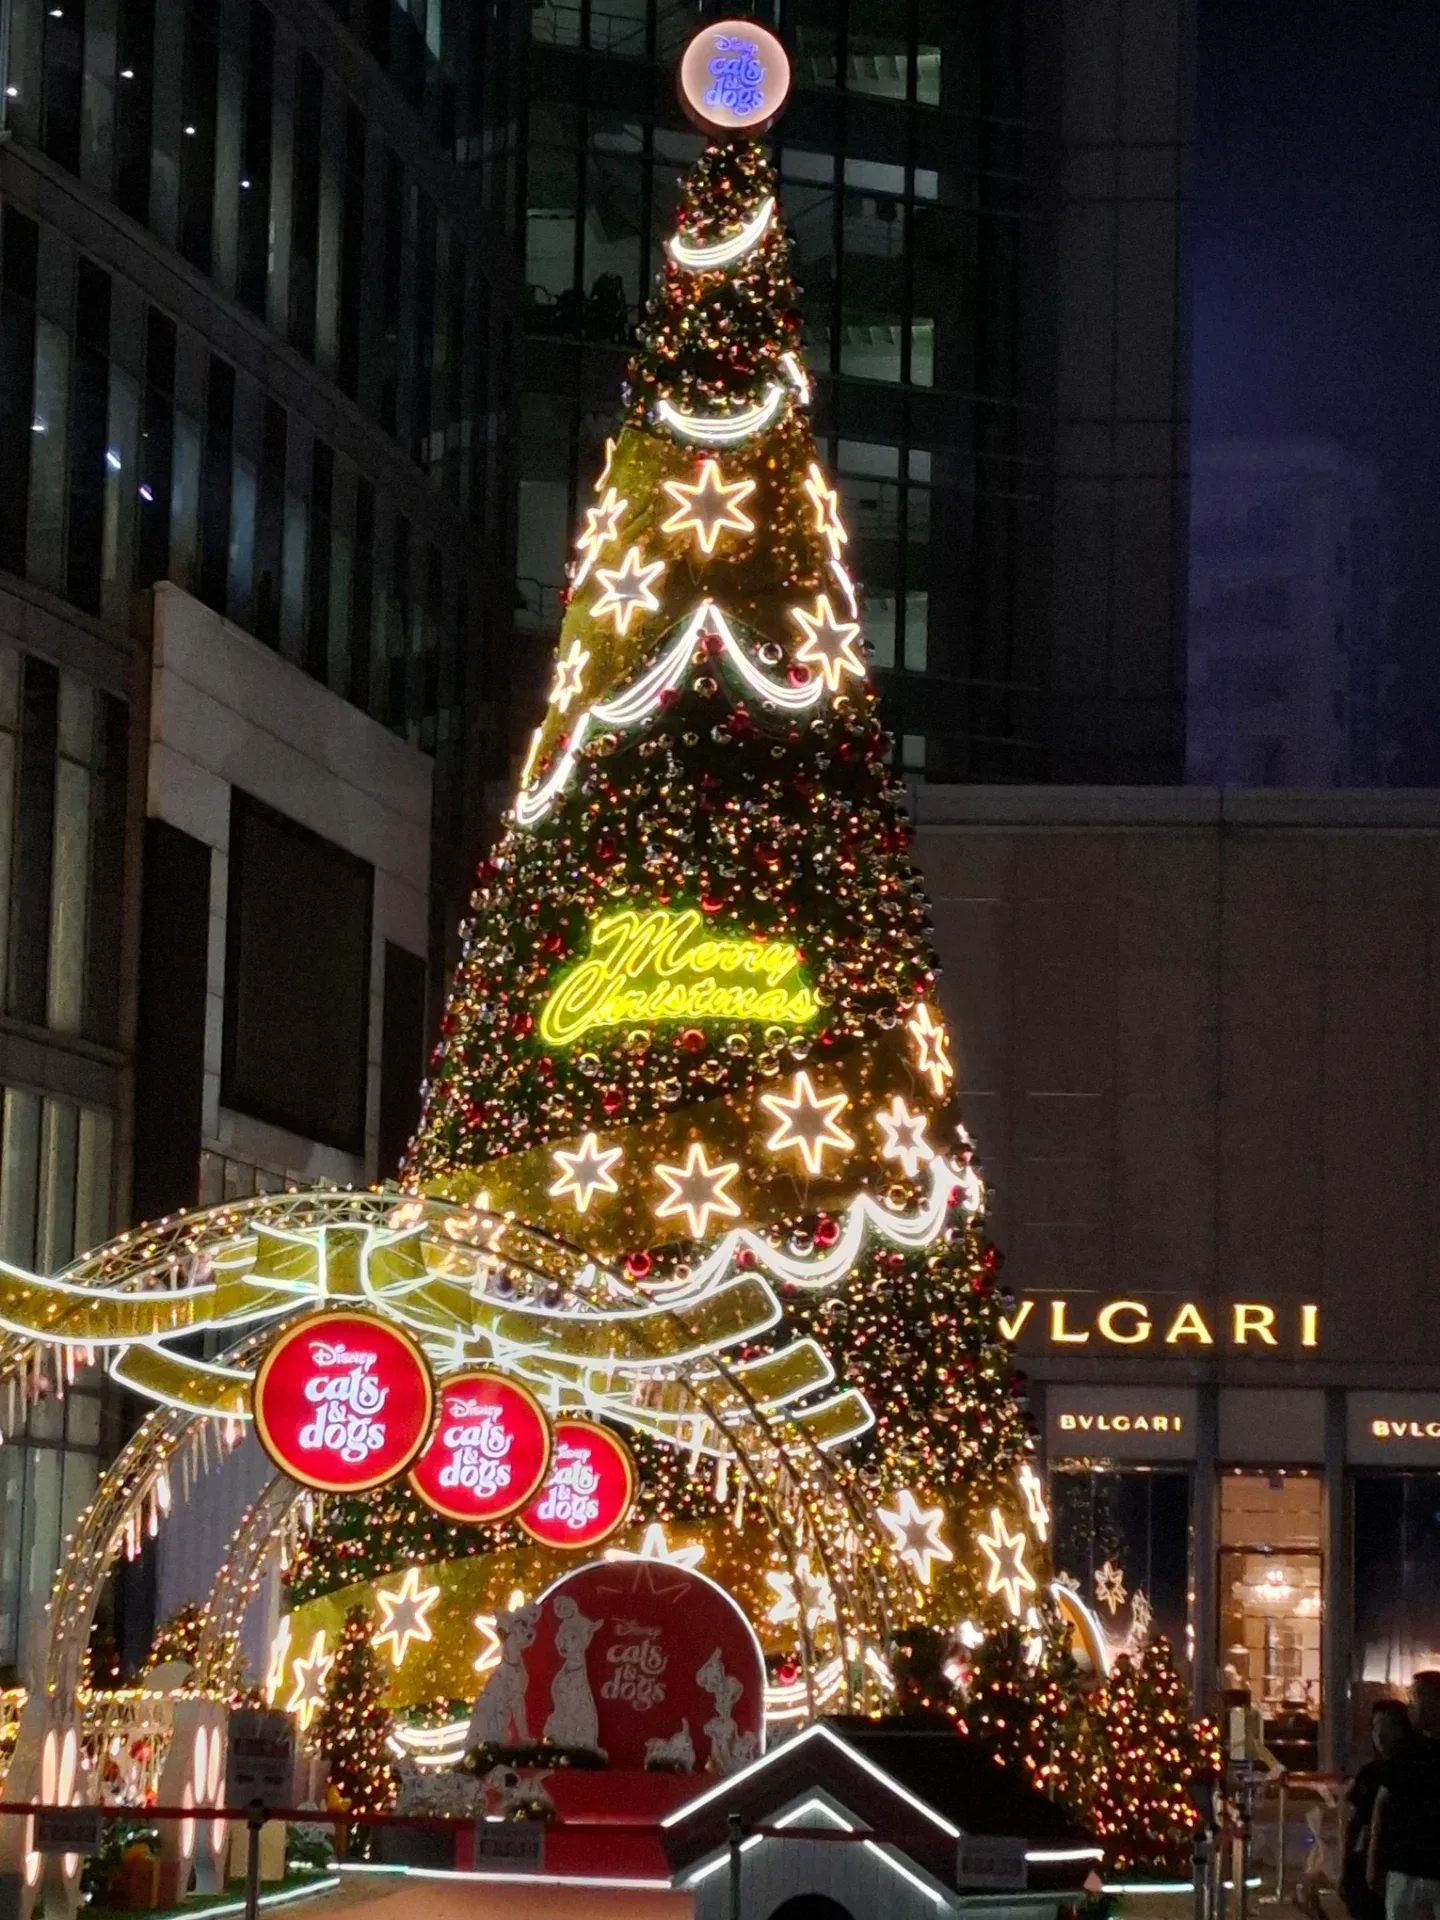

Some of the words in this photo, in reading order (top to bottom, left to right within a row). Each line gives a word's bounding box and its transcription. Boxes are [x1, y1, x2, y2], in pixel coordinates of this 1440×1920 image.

[708, 51, 766, 88] cats
[704, 76, 764, 115] dogs
[592, 909, 798, 986] Merry
[540, 960, 819, 1045] Christmas
[998, 1301, 1318, 1346] VLGARI
[308, 1341, 377, 1372] Disney
[305, 1366, 390, 1415] cats
[446, 1397, 503, 1423] Disney
[328, 1400, 348, 1422] &
[1060, 1414, 1181, 1431] BVLGARI
[299, 1402, 386, 1462] dogs
[443, 1417, 514, 1458] cats
[439, 1448, 511, 1497] dogs
[463, 1446, 478, 1465] &
[556, 1443, 591, 1464] isney
[537, 1486, 599, 1529] dogs
[606, 1639, 668, 1674] cats
[601, 1666, 666, 1711] dogs
